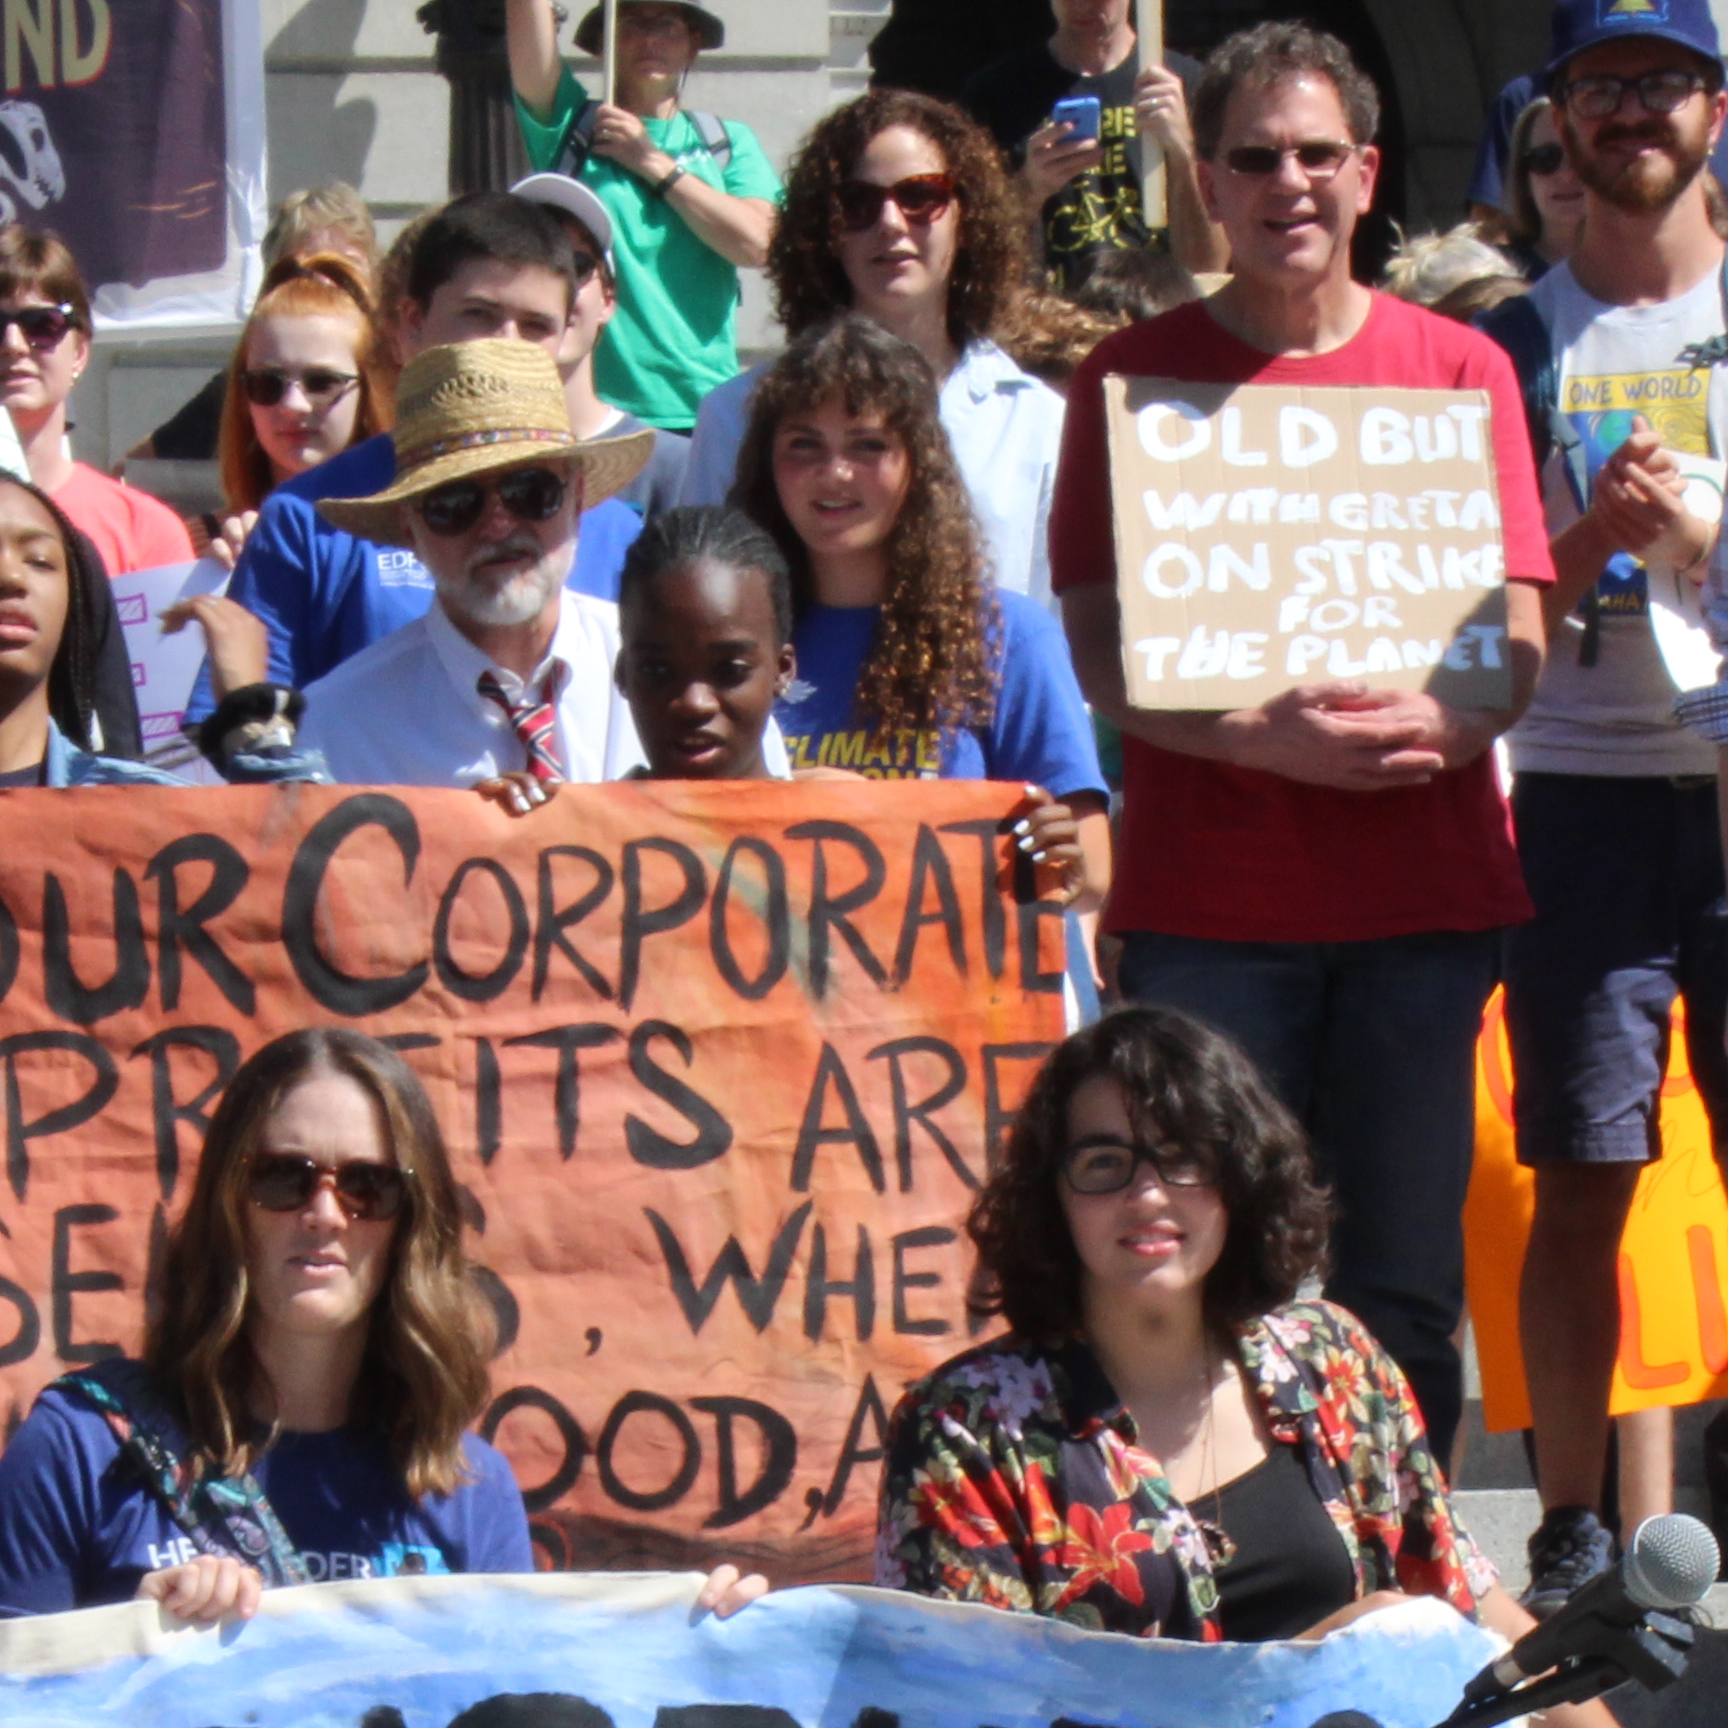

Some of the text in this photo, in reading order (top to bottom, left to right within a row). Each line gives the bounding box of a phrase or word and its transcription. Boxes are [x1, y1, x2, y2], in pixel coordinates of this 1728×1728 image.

[1569, 375, 1704, 405] ONE WORLD
[1136, 403, 1491, 467] OLD BUT
[1142, 486, 1502, 532] WITH GRETA
[1142, 538, 1505, 600] ON STRIKE
[1278, 595, 1402, 633] FOR
[1134, 625, 1505, 682] THE PLANET
